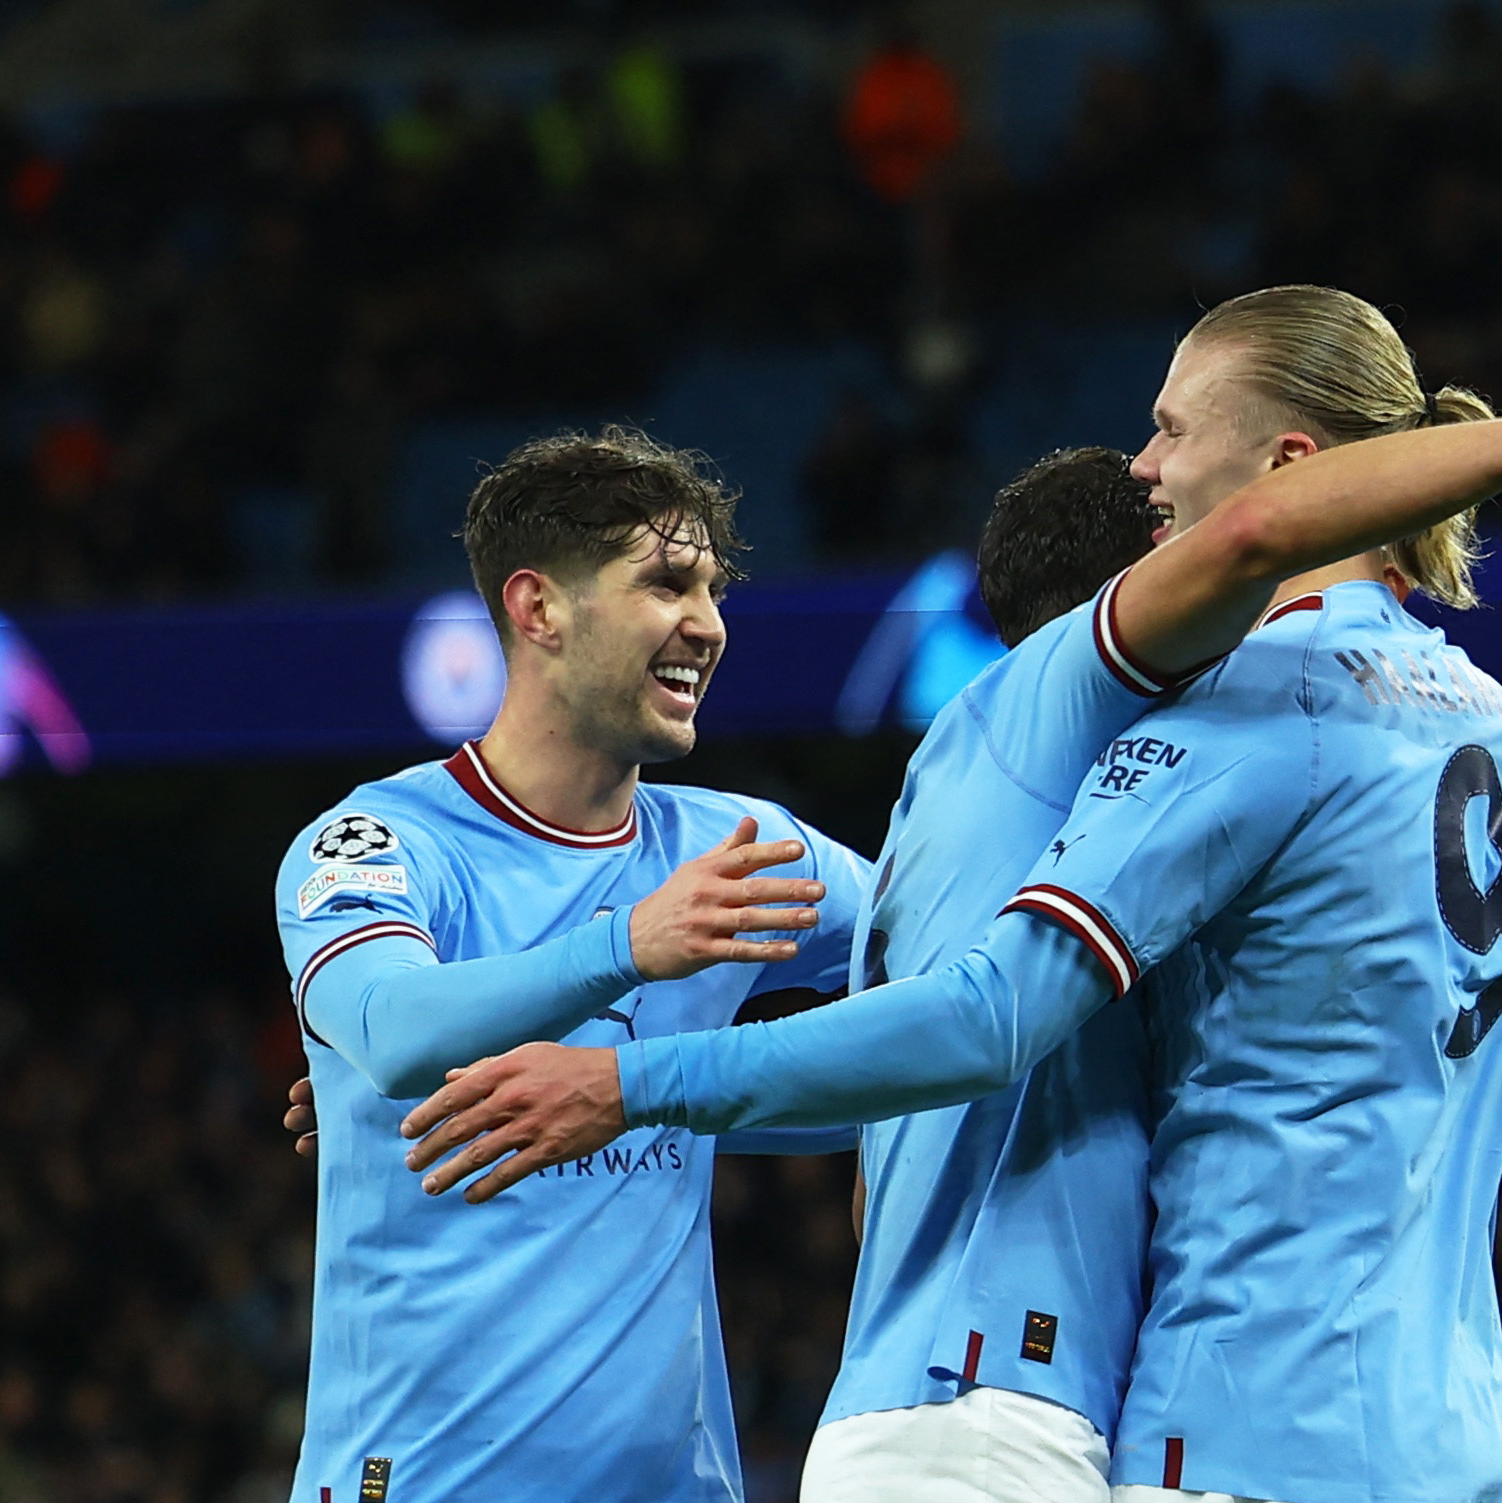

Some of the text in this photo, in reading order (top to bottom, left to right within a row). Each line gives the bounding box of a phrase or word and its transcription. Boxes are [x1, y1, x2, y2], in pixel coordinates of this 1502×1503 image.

[1098, 765, 1150, 792] RE
[301, 872, 403, 905] FOUNDATION
[536, 1143, 682, 1178] IRWAYS
